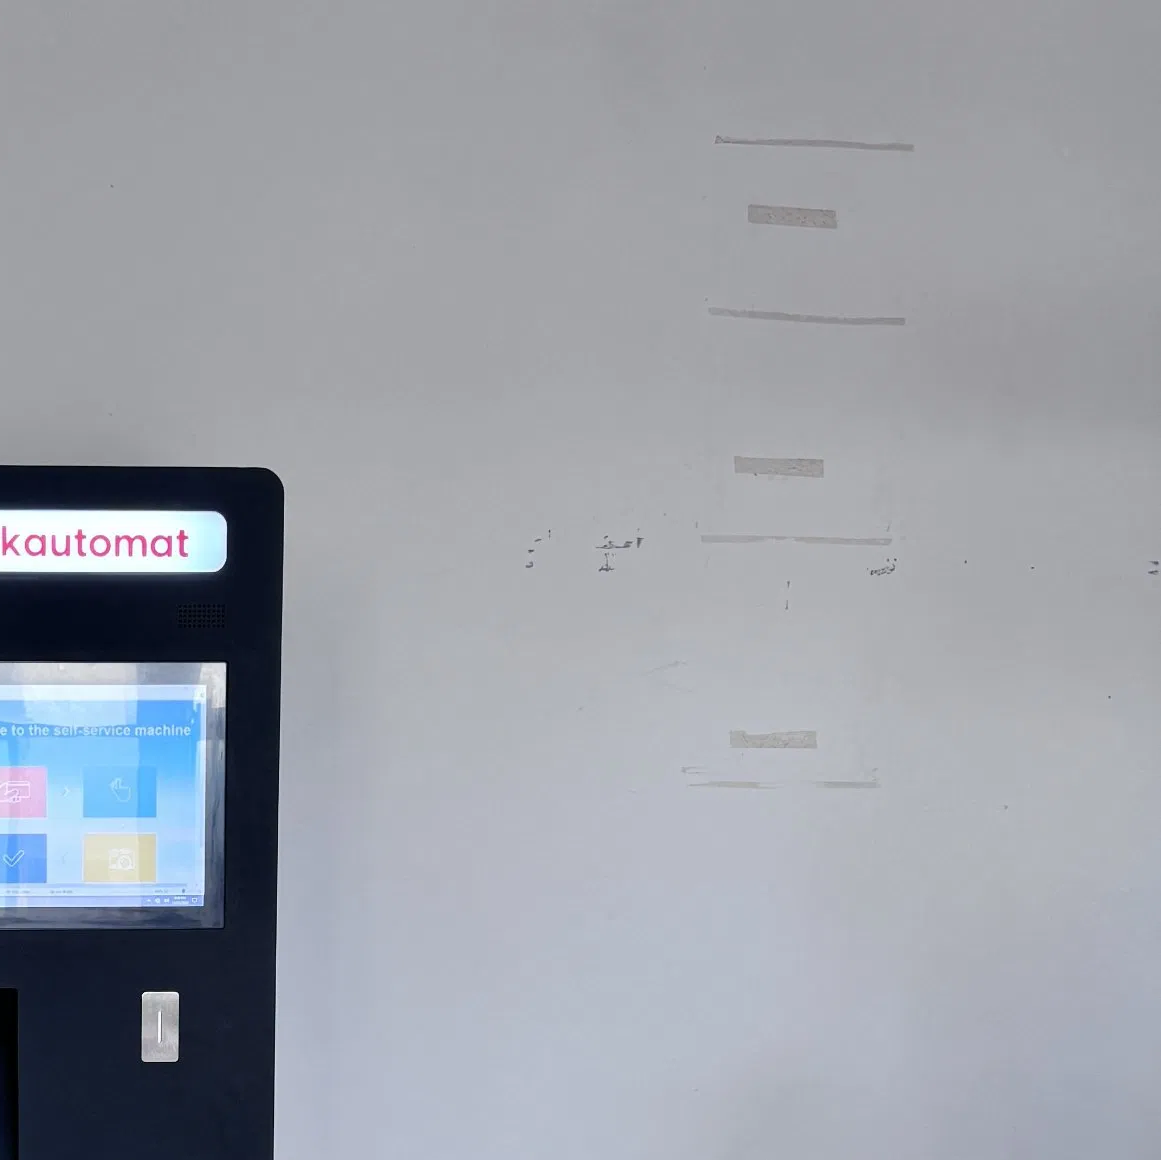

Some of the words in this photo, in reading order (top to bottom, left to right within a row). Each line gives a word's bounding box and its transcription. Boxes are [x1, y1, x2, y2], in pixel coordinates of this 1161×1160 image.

[11, 724, 25, 737] to
[29, 724, 49, 737] the
[53, 724, 131, 737] self-service
[135, 724, 191, 737] machine
